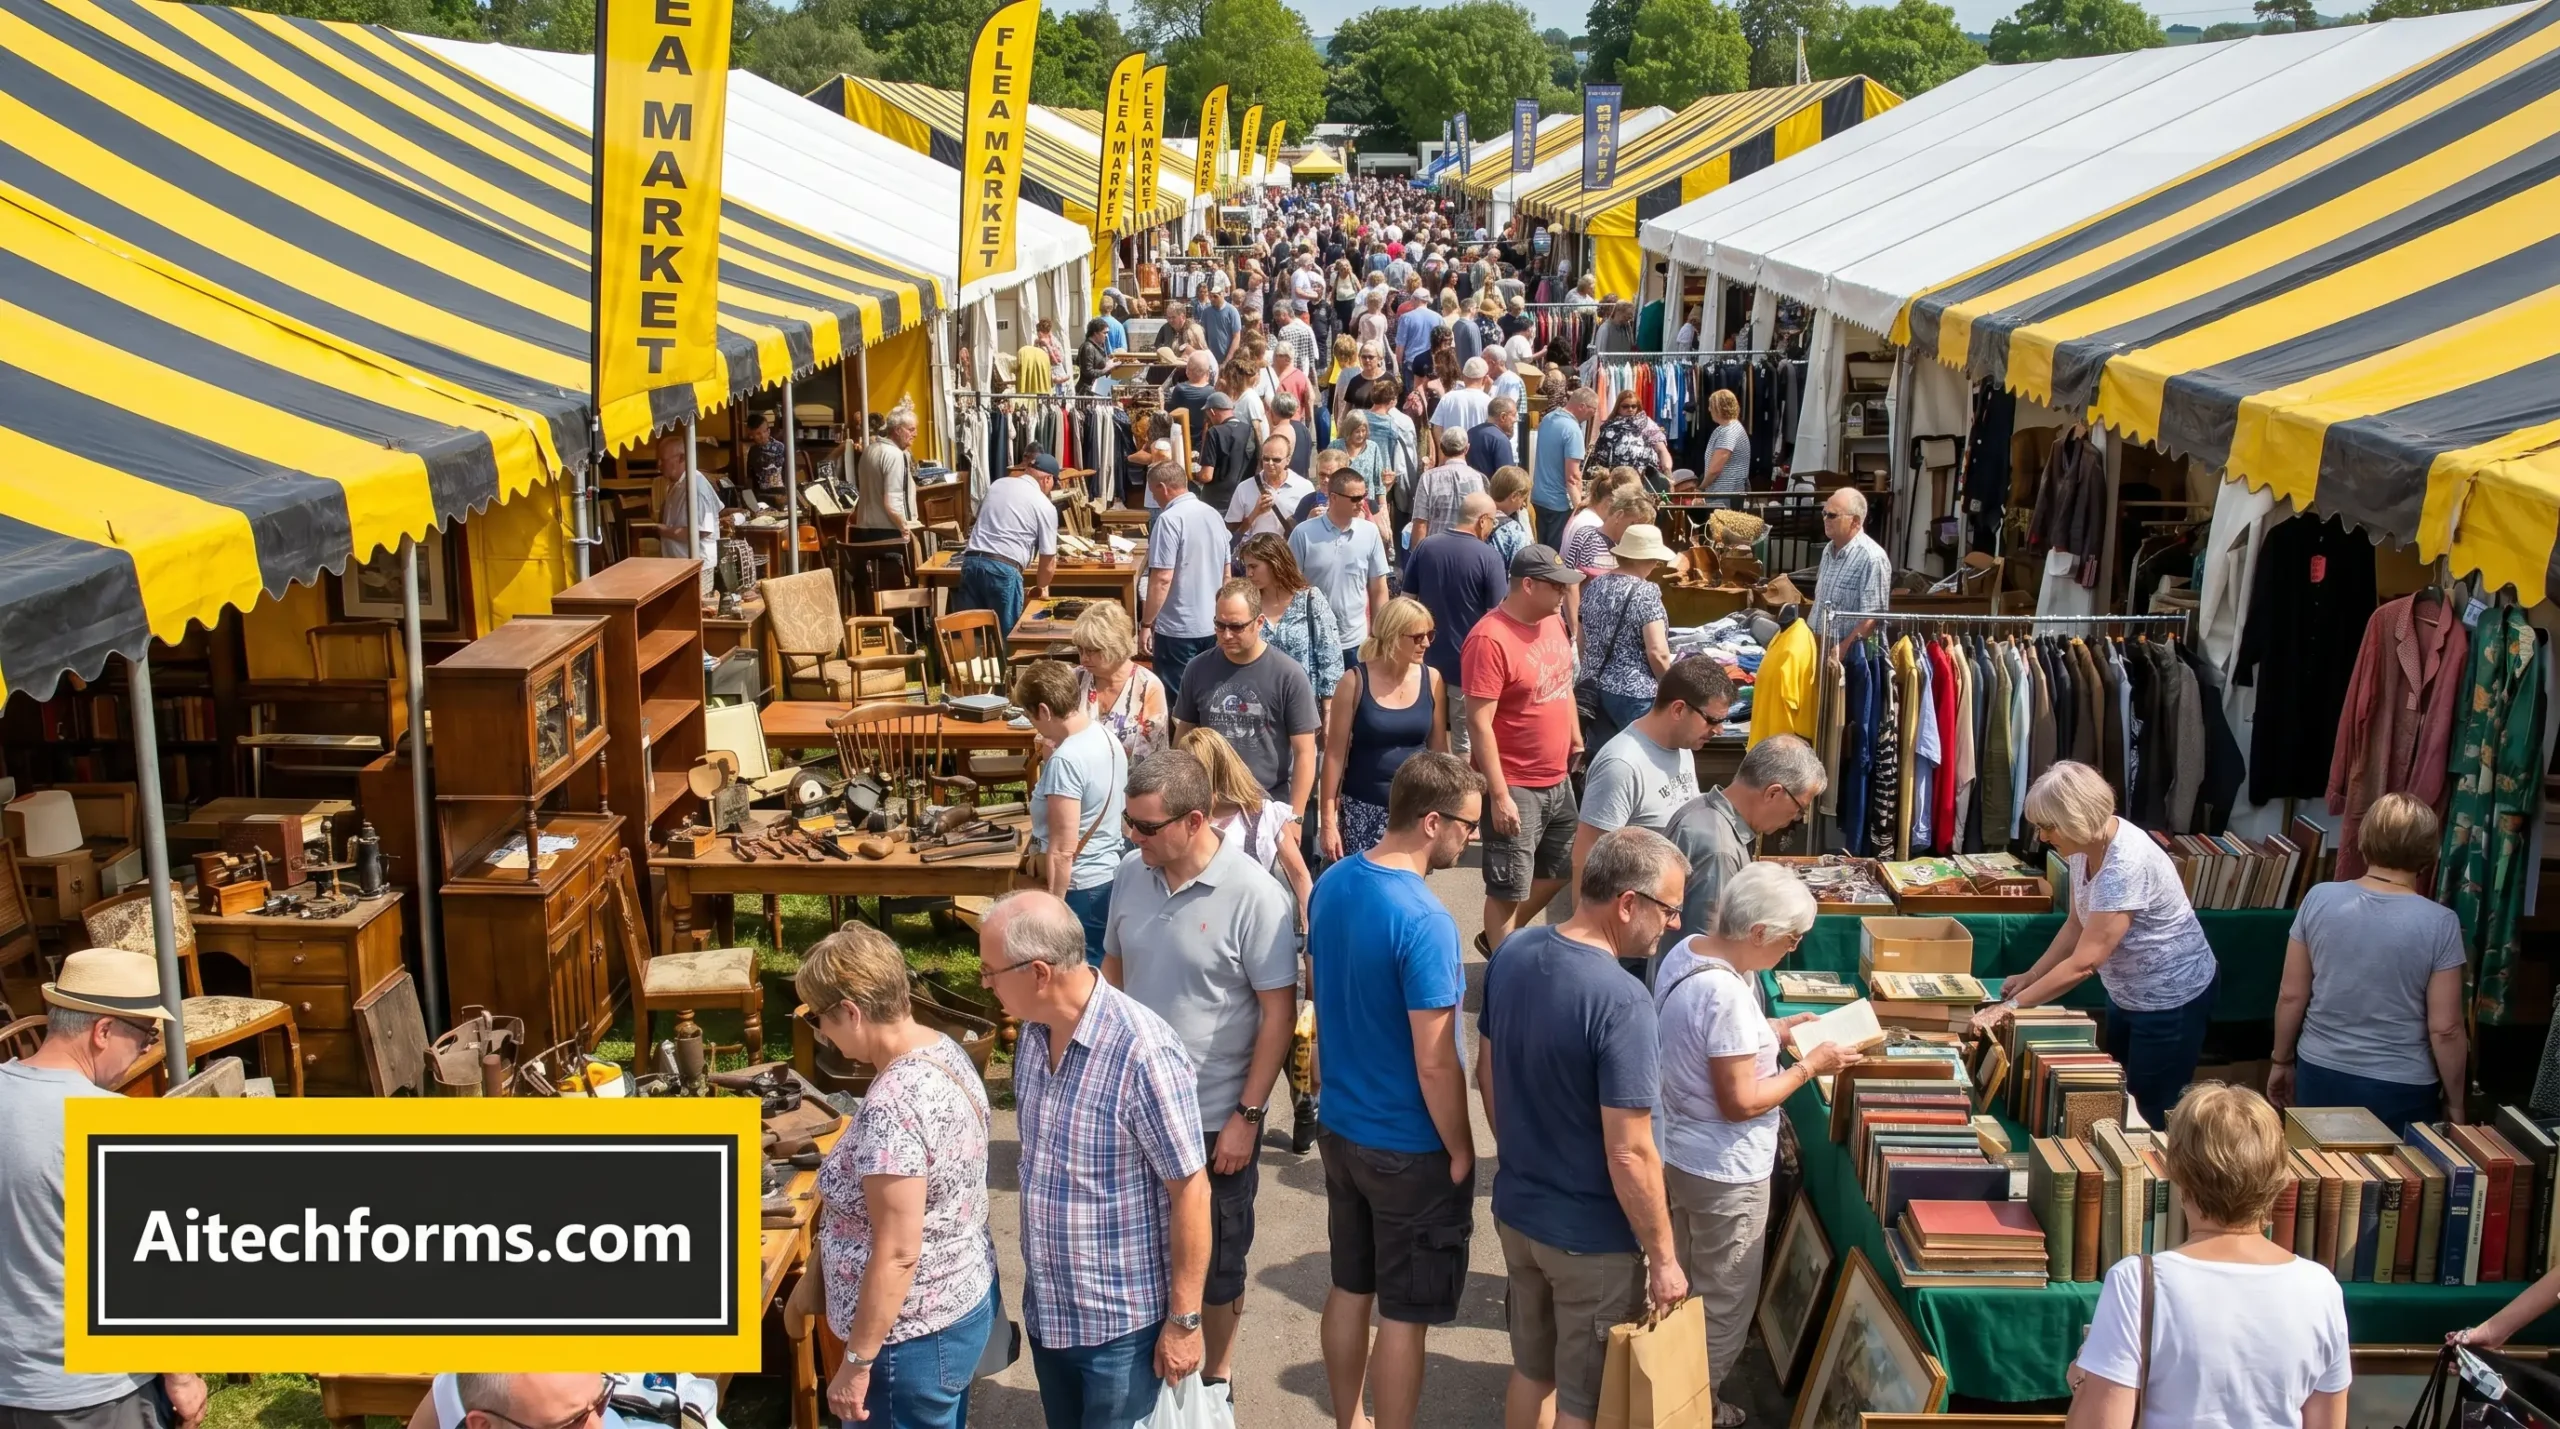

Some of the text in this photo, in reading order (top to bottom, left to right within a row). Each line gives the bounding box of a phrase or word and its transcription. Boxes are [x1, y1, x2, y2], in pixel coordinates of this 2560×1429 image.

[979, 27, 1015, 268] FLEA MARKET
[1105, 73, 1131, 226] FLEA MARKET
[1141, 82, 1154, 209] FLEA MARKET
[1206, 97, 1219, 136] FLEA
[636, 100, 693, 374] MARKET
